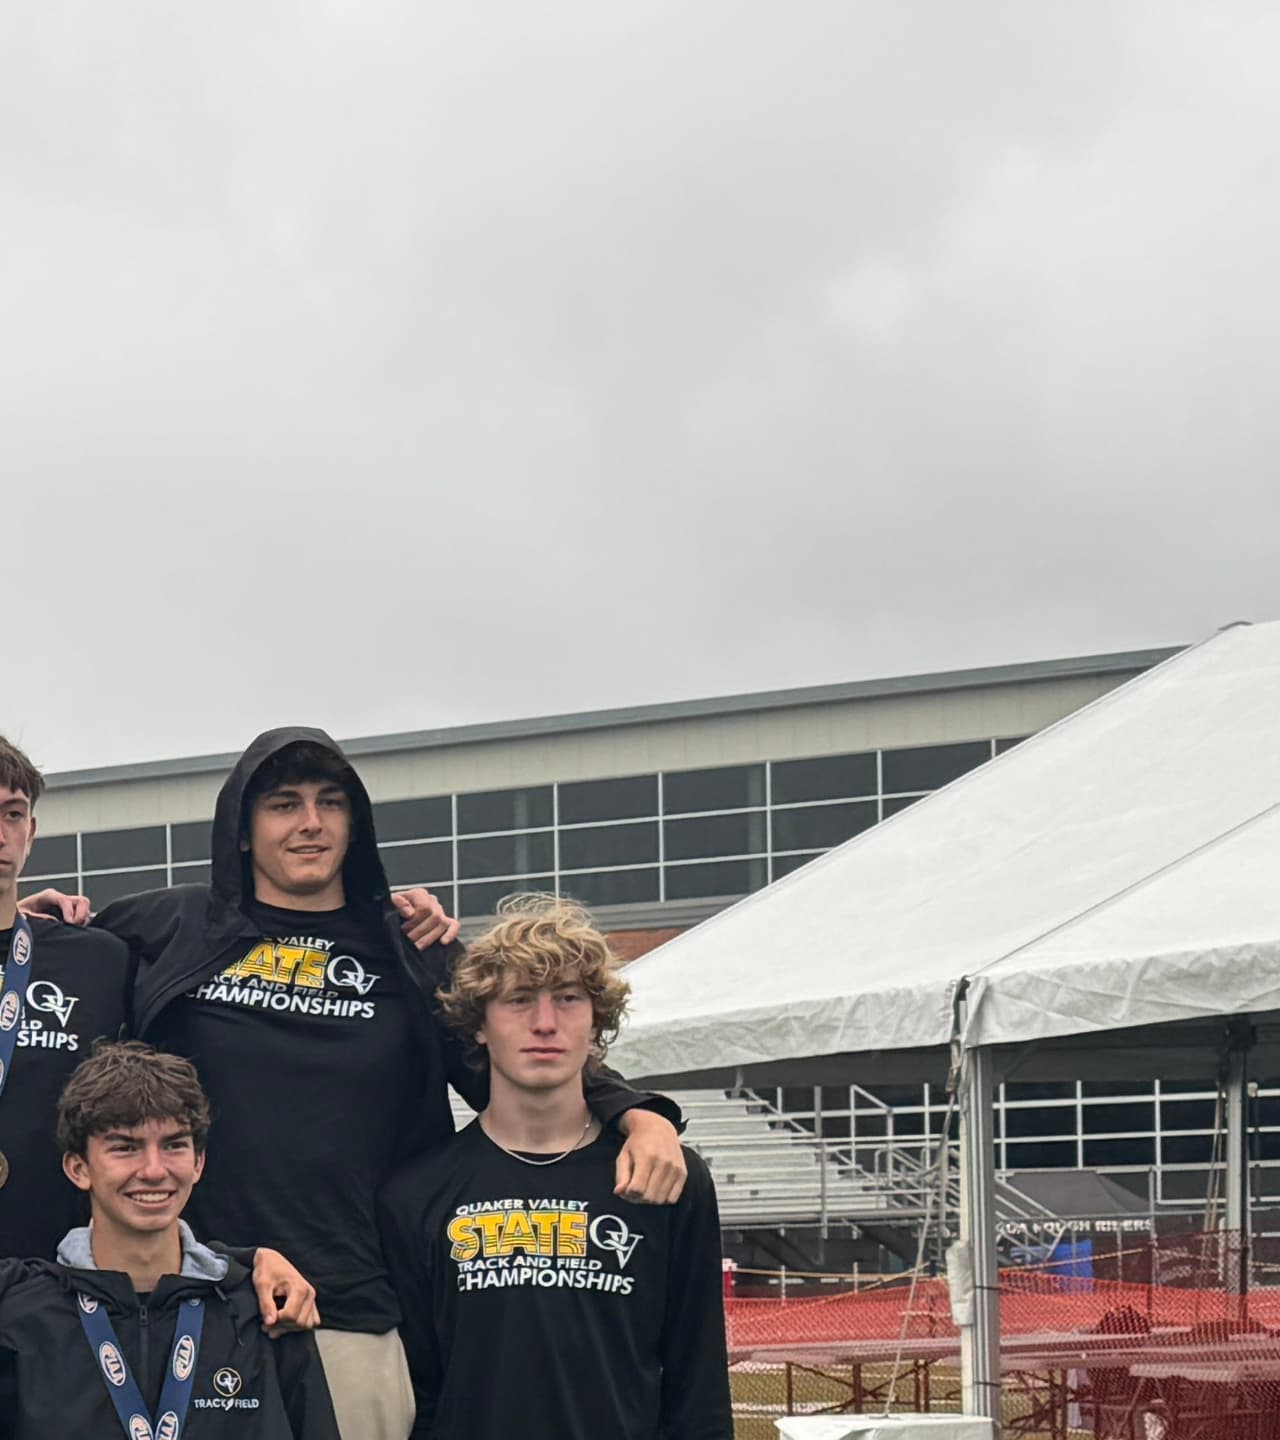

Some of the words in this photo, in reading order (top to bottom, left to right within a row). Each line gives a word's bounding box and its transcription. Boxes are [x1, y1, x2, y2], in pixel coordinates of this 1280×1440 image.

[276, 936, 335, 951] VALLEY
[247, 977, 287, 993] AND
[26, 980, 79, 1029] QV
[188, 982, 376, 1019] HAMPIONSHIPS
[456, 1199, 524, 1216] QUAKER
[527, 1199, 589, 1211] VALLEY
[447, 1210, 588, 1262] STATE
[589, 1214, 644, 1270] QV
[457, 1255, 510, 1273] TRACK
[513, 1255, 552, 1268] AND
[557, 1258, 602, 1271] FIELD
[457, 1268, 636, 1296] CHAMPIONSHIPS
[193, 1398, 226, 1409] TRACK
[234, 1398, 260, 1409] FIELD
